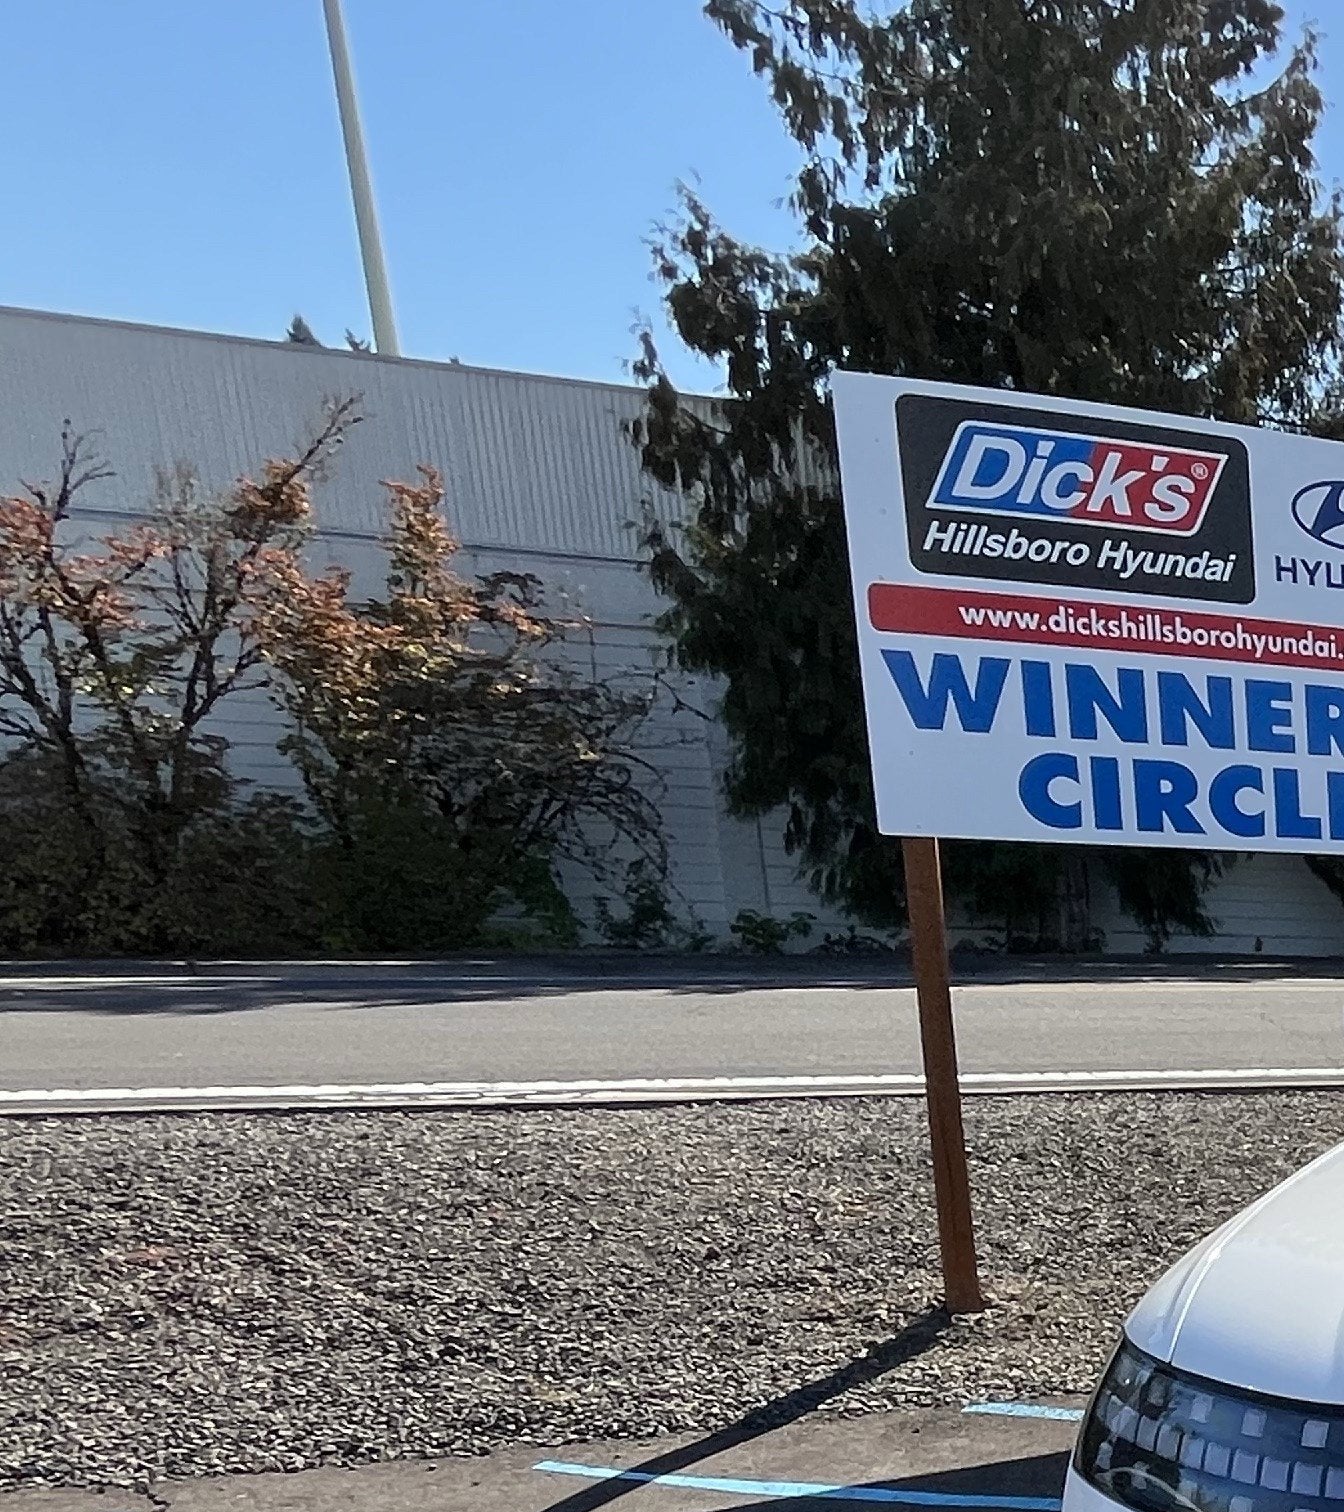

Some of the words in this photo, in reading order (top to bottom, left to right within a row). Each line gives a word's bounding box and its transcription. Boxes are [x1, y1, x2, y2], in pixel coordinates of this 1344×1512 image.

[952, 434, 1197, 523] Dick's
[923, 521, 1087, 567] Hillsboro
[1097, 539, 1237, 583] Hyundai
